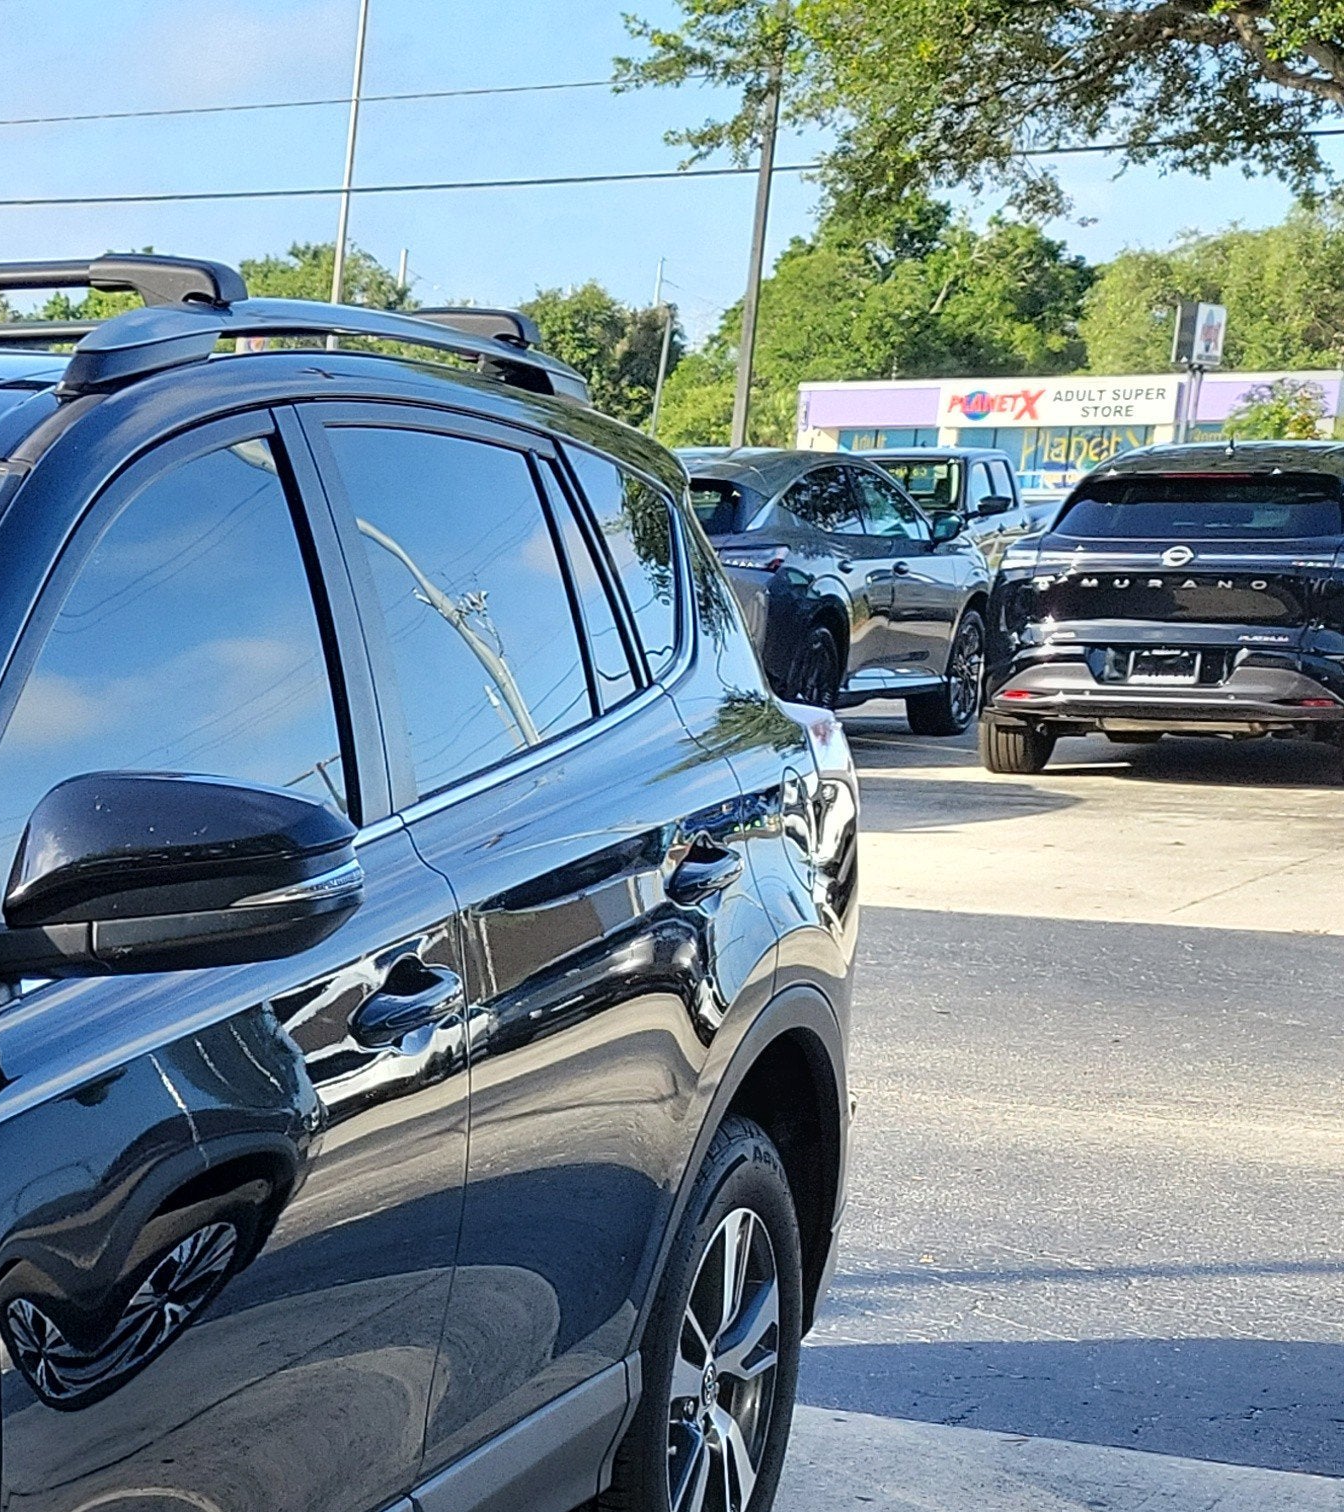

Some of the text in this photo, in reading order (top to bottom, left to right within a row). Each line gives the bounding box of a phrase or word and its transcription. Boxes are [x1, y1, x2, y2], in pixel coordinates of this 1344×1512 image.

[1053, 388, 1167, 402] ADULT SUPER
[947, 395, 1021, 413] PLANET
[1080, 405, 1135, 418] STORE
[1079, 578, 1268, 590] MURANO
